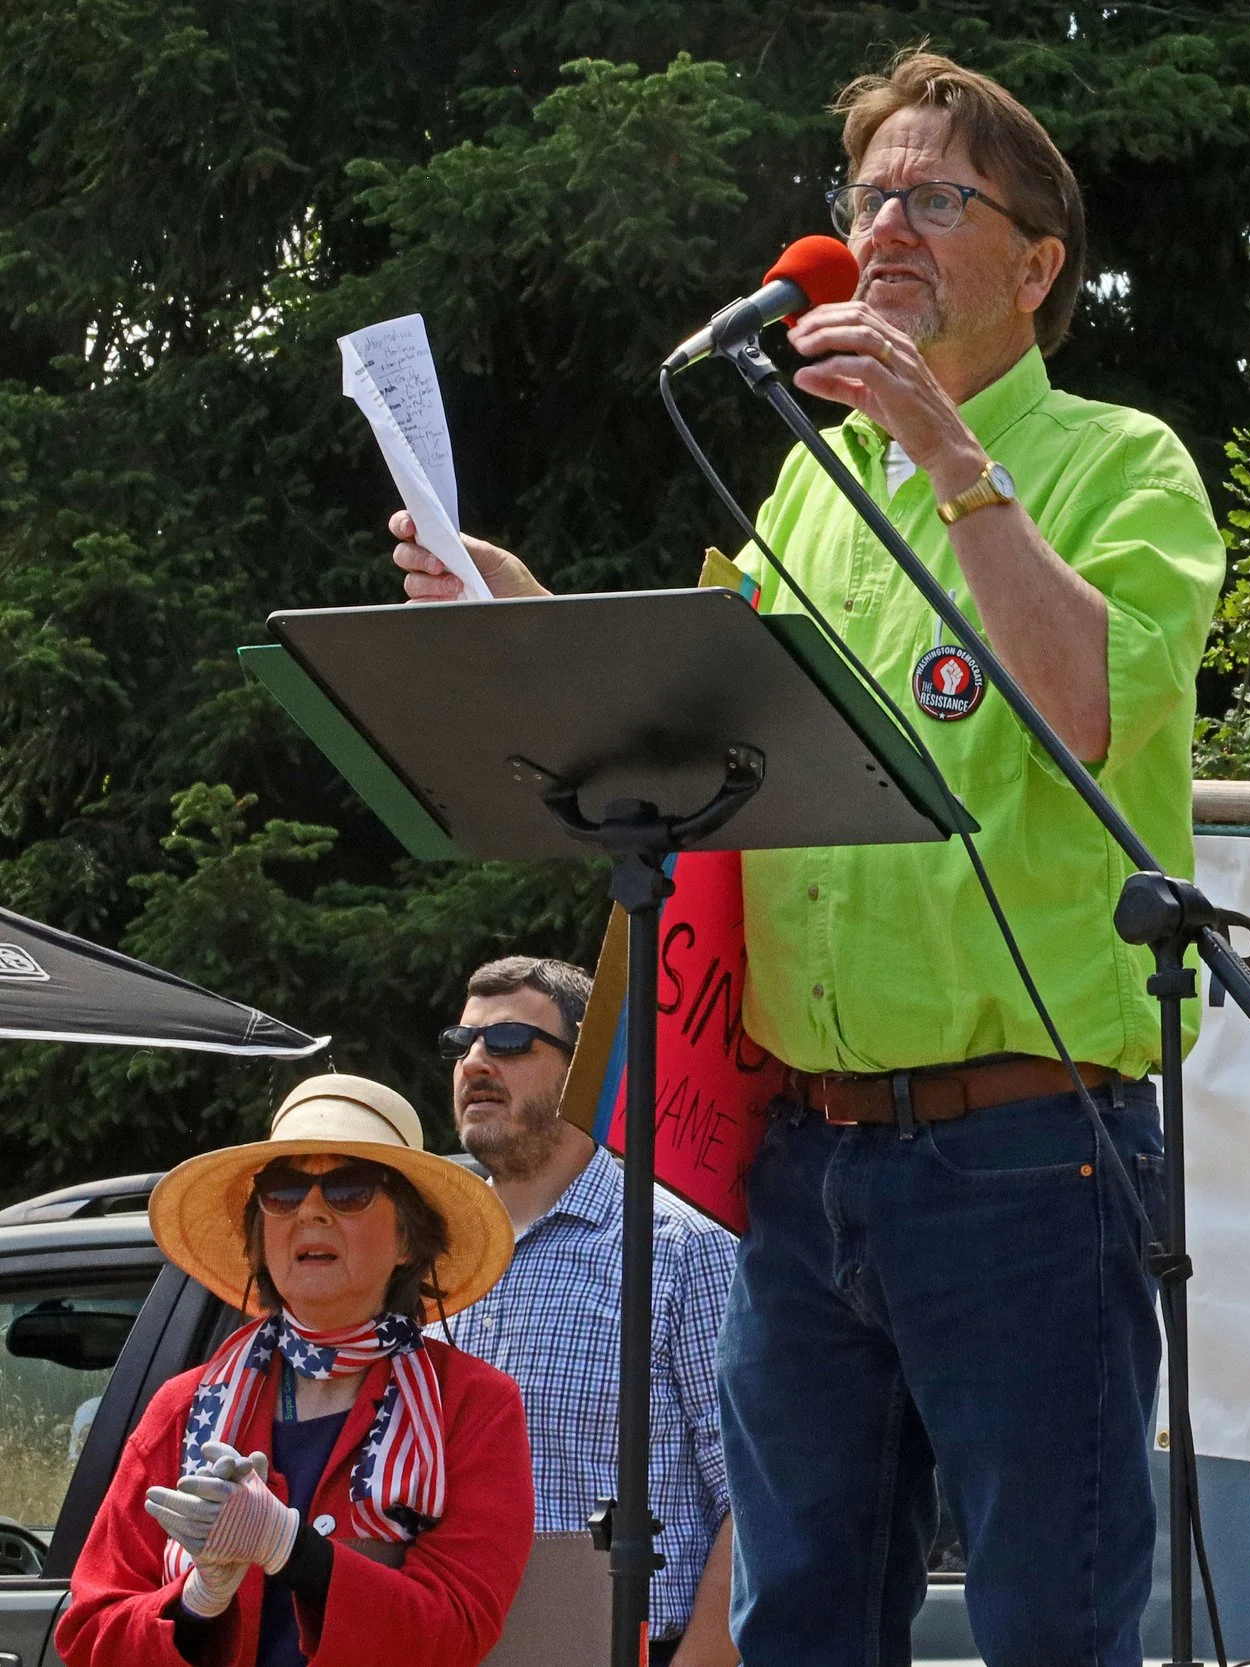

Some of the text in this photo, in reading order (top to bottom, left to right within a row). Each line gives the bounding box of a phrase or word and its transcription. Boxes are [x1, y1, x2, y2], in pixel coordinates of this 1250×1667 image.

[915, 646, 983, 687] WASHINGTON DEMOCRATS
[921, 681, 934, 694] THE
[919, 692, 969, 713] RESISTANCE
